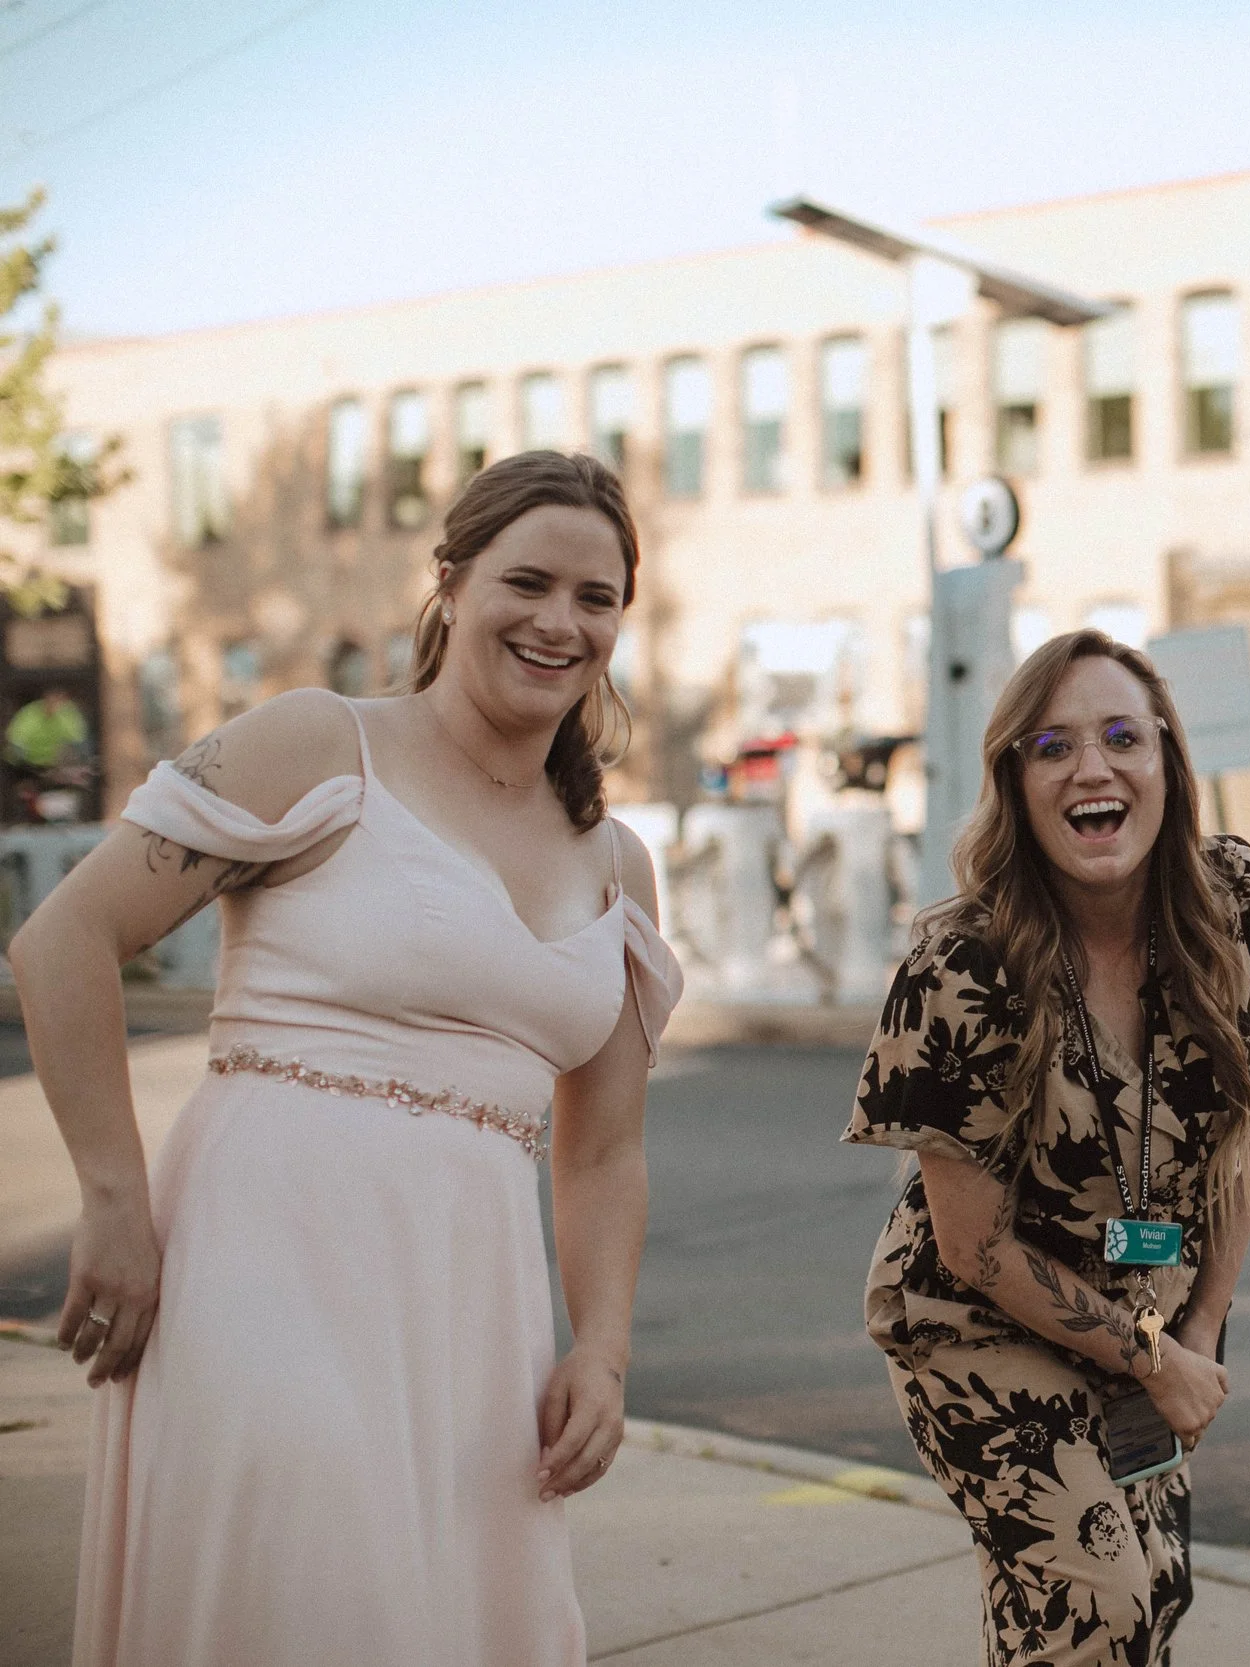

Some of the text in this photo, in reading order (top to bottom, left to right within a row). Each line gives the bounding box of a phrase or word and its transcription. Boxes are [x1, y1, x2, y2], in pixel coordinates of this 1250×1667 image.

[1062, 953, 1099, 1082] odman Community Center
[1145, 1083, 1153, 1134] Community
[1116, 1165, 1135, 1214] STAFF
[1141, 1136, 1150, 1211] Goodman
[1139, 1227, 1166, 1241] Vivian
